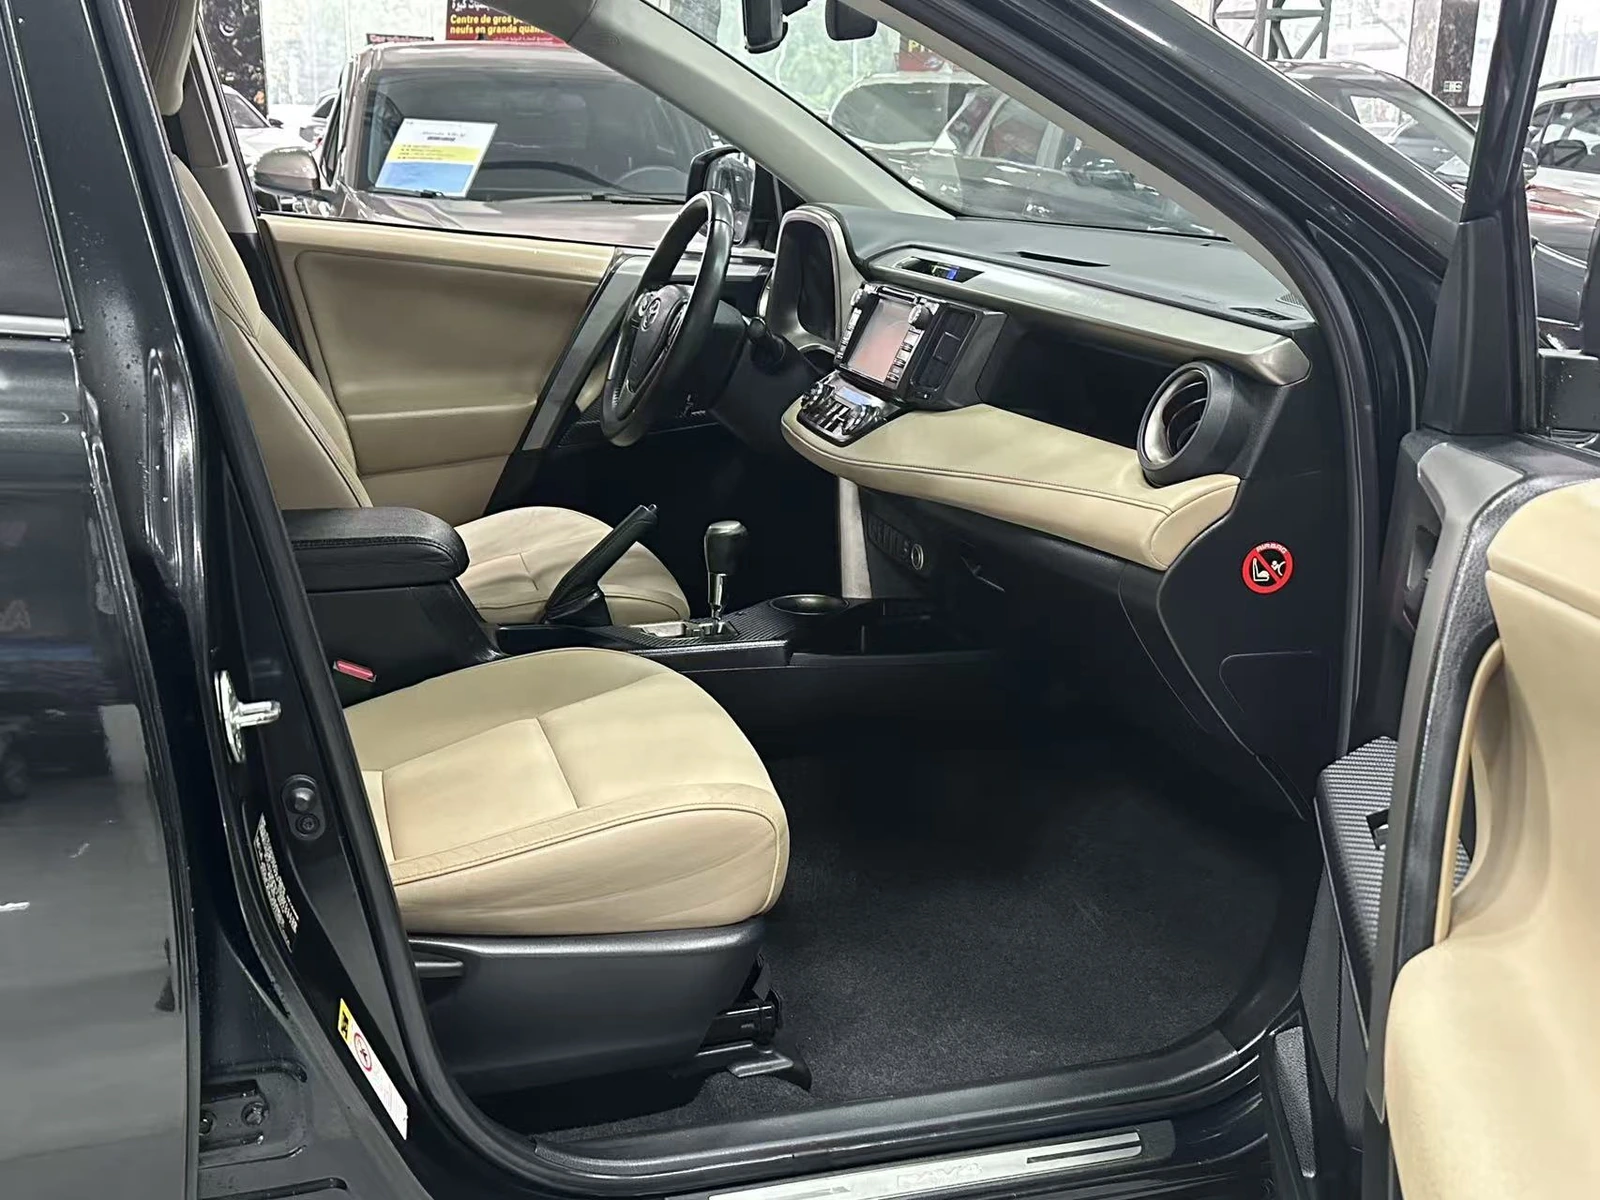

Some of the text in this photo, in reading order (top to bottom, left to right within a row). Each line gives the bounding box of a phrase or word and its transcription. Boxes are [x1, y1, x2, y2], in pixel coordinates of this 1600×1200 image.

[450, 14, 479, 24] Centre
[480, 14, 492, 24] de
[493, 15, 512, 25] gros
[450, 25, 474, 34] neufs
[475, 26, 486, 34] en
[487, 24, 517, 36] grande
[1255, 543, 1288, 554] AIRBAG
